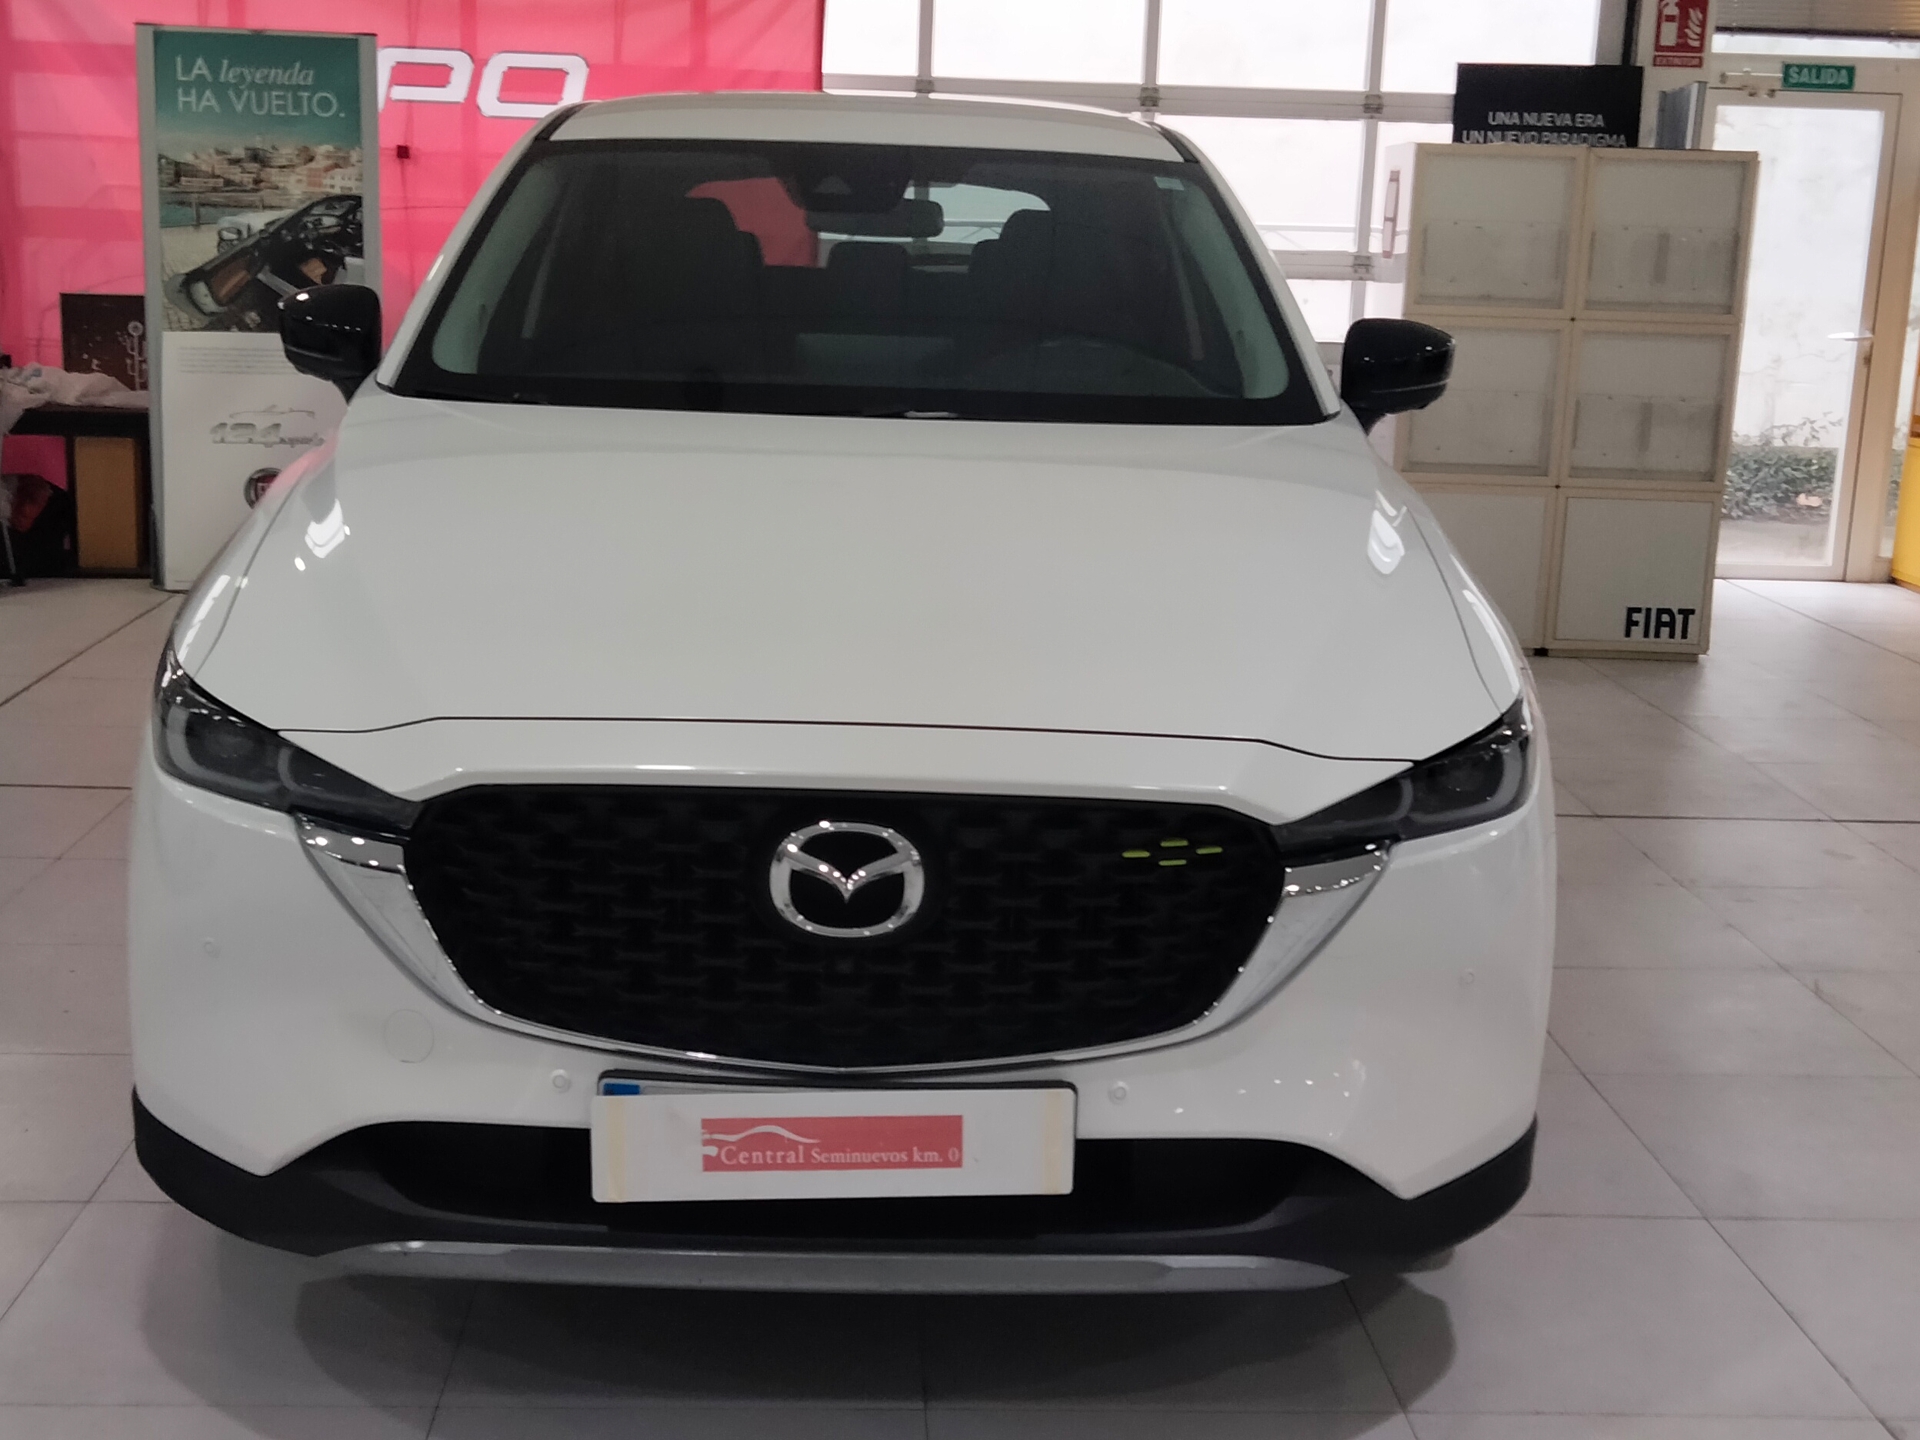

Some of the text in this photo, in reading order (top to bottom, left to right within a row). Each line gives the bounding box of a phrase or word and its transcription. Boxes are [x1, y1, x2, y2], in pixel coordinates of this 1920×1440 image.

[175, 54, 315, 89] LA leyenda
[1788, 67, 1849, 85] SALIDA
[177, 87, 346, 118] HA VUELTO.
[1487, 111, 1605, 128] UNA NUEVA ERA
[1462, 130, 1628, 148] UN NUEVO PARADIGMA
[1624, 607, 1696, 640] FIAT
[720, 1145, 960, 1165] Central Seminuevos km. 0
